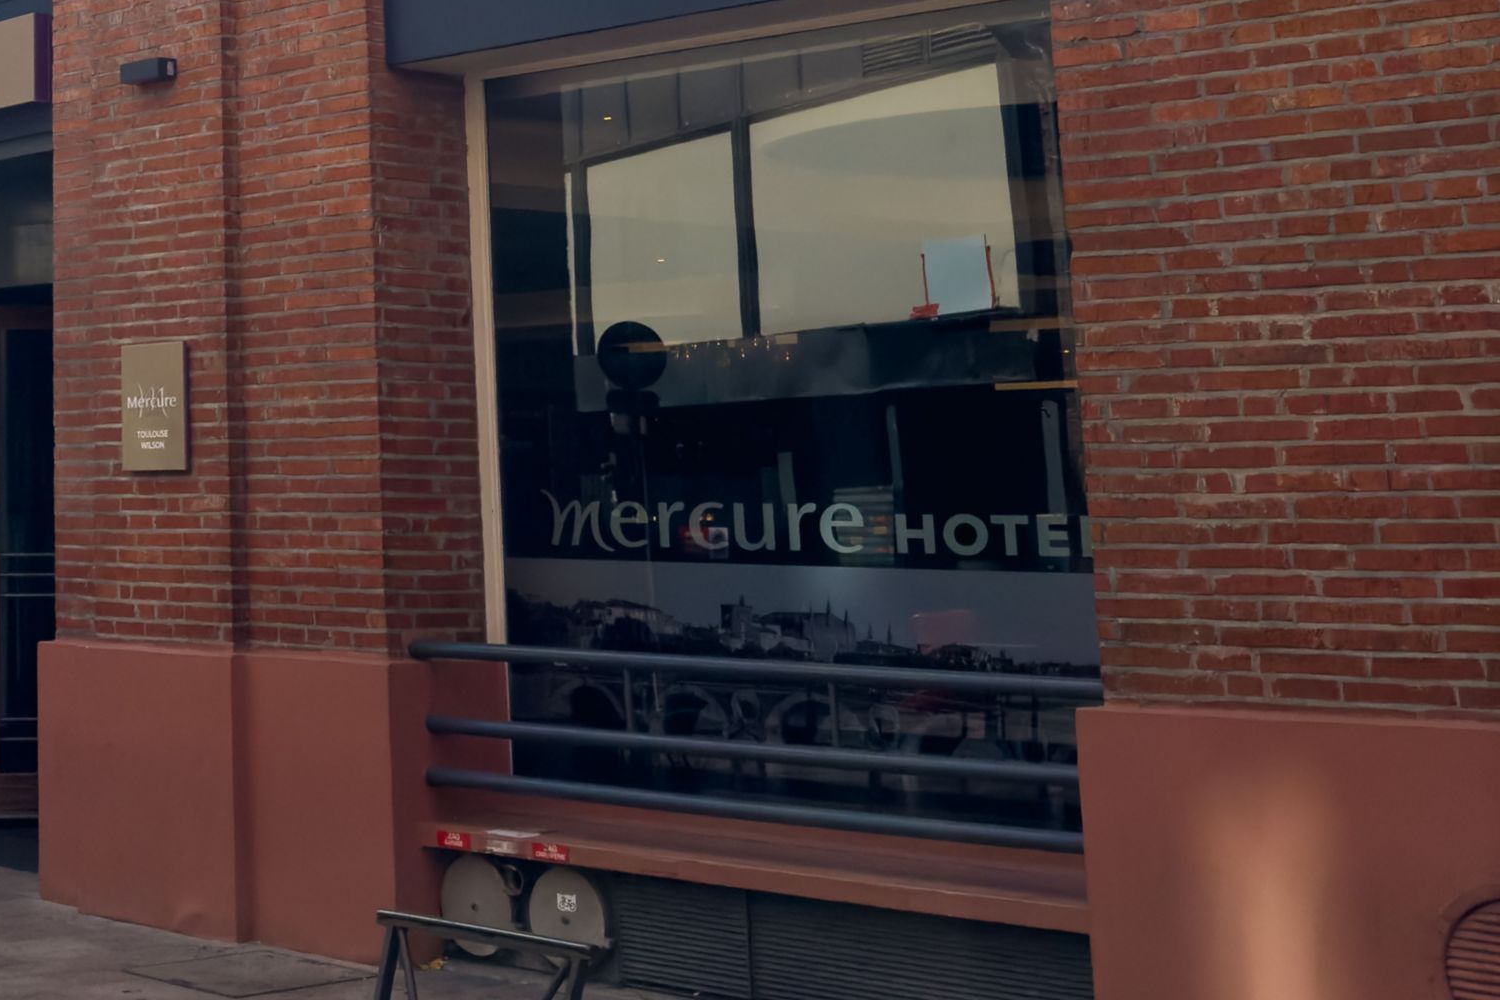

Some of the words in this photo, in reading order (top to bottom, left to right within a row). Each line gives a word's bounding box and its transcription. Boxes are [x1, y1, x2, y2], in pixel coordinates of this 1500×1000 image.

[127, 396, 177, 409] Mercure
[137, 429, 169, 439] TOULOUSE
[141, 441, 165, 449] WILSON
